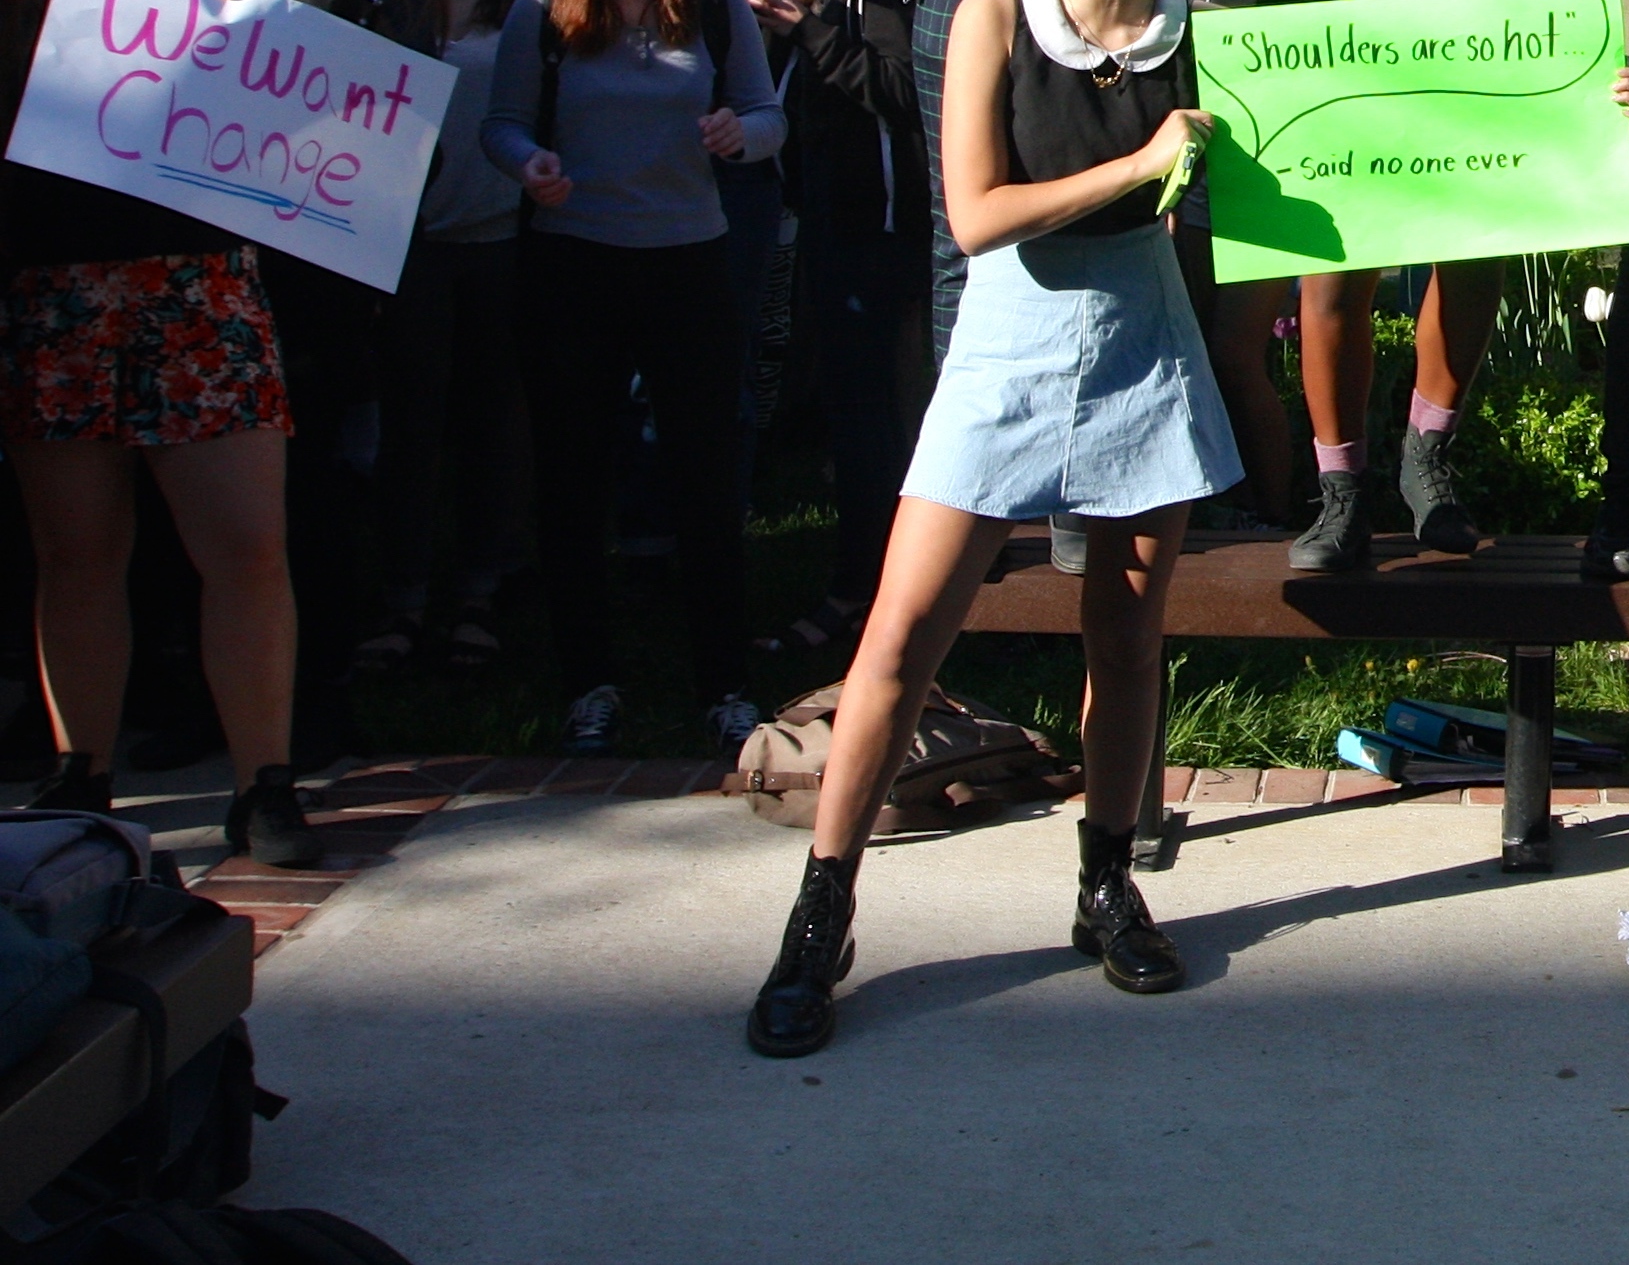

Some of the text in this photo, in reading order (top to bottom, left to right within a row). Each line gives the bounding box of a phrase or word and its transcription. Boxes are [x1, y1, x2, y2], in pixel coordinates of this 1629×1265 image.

[239, 19, 413, 136] Want
[1411, 35, 1456, 62] are
[1466, 36, 1495, 62] so
[98, 69, 362, 222] Change
[1465, 152, 1529, 172] ever
